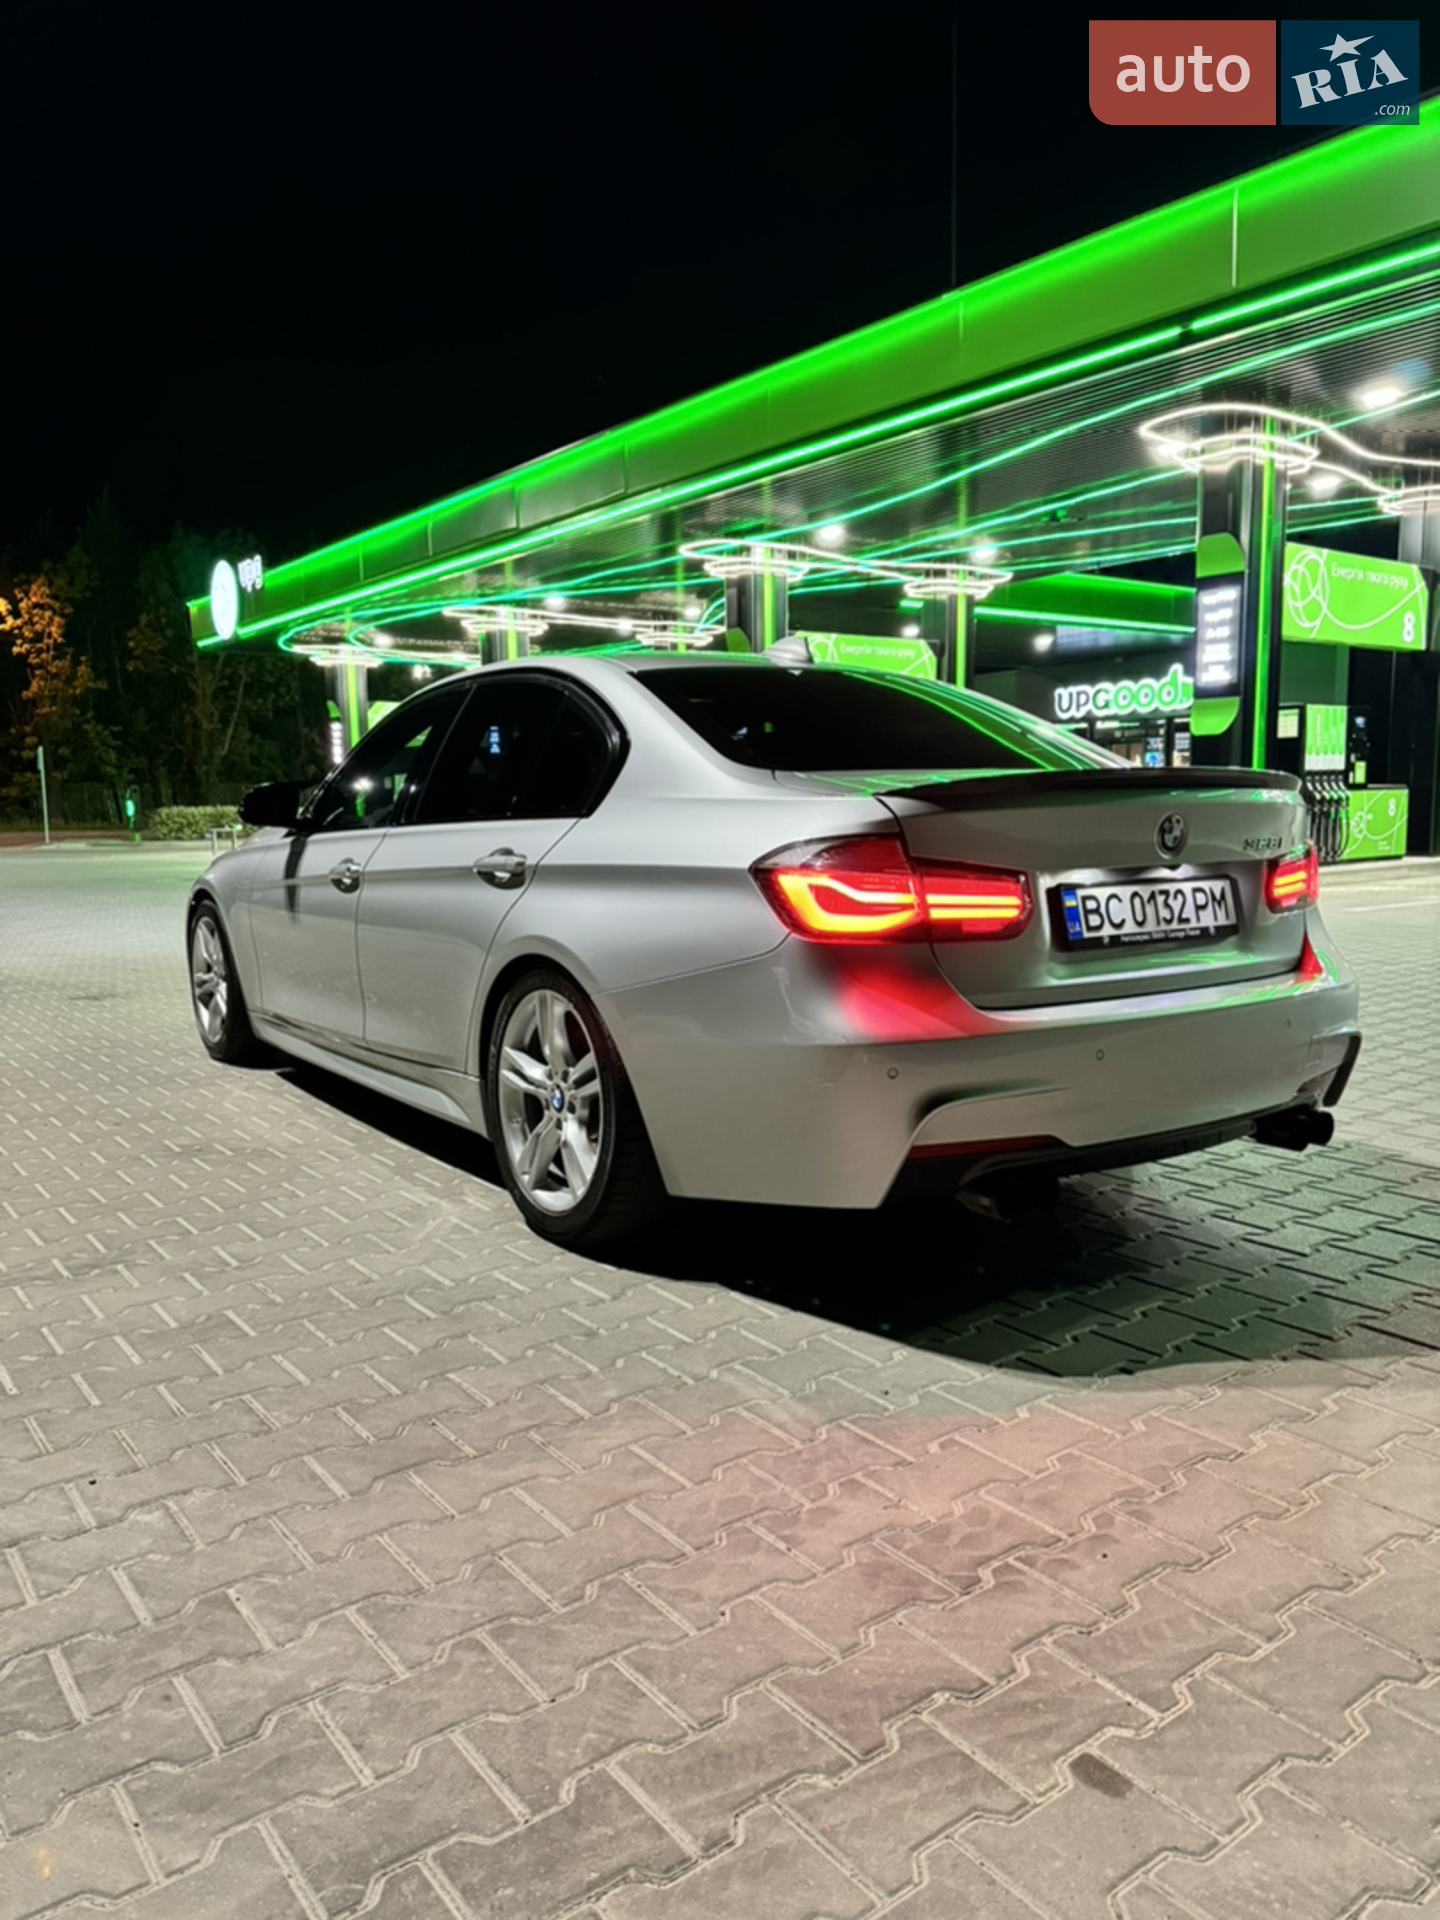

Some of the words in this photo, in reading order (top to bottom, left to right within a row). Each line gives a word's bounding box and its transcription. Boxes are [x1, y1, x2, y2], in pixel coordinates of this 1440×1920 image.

[238, 554, 262, 592] upg
[1331, 562, 1364, 581] Енергія
[1366, 571, 1388, 585] твого
[1389, 575, 1408, 591] руху
[1403, 611, 1415, 643] 8
[1081, 893, 1127, 932] BC
[1130, 889, 1190, 926] 0132
[1192, 886, 1229, 924] PM
